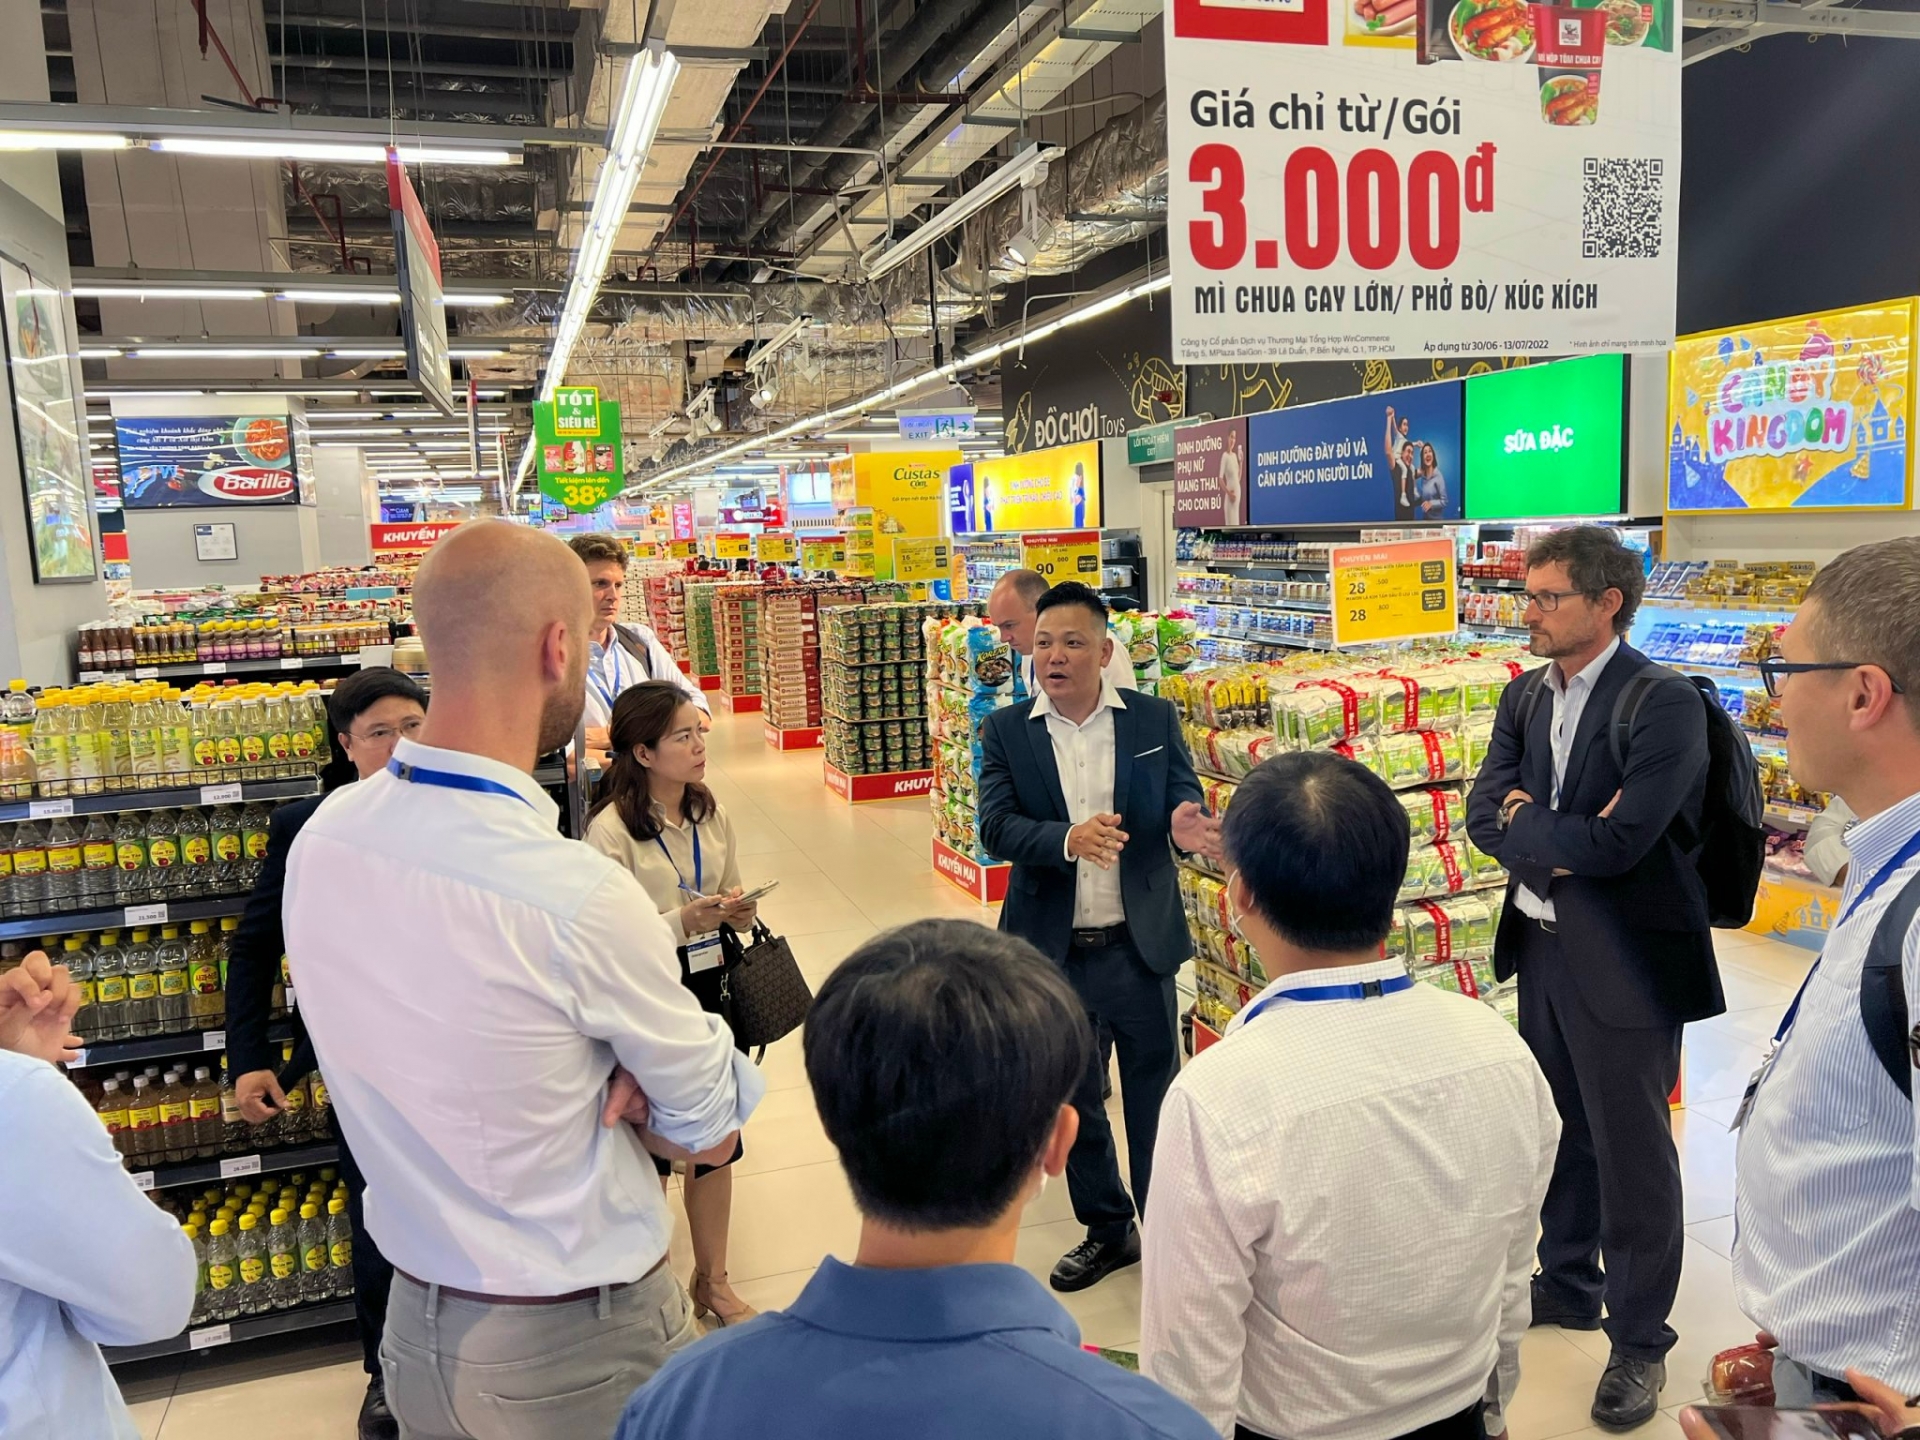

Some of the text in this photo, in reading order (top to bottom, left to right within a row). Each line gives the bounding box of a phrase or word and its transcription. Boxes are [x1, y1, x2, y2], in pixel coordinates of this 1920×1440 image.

[1190, 87, 1461, 140] Giá chỉ từ/Gói
[1188, 141, 1497, 270] 3.000đ
[1195, 277, 1598, 315] MÌ CHUA CAY LỚN/ PHỞ BÒ/ XÚC XÍCH
[1180, 338, 1200, 347] Công
[1201, 338, 1208, 347] ty
[1240, 336, 1256, 346] Dịch
[1267, 336, 1294, 346] Thương
[1309, 334, 1326, 345] Tổng
[1327, 335, 1342, 344] Hợp
[1343, 335, 1390, 343] WinCommerce
[1423, 340, 1549, 352] Áp dụng từ 30/06 13/07/2022
[1611, 340, 1627, 348] mang
[1268, 347, 1277, 355] 39
[1368, 345, 1395, 353] TP.HCM
[1721, 361, 1830, 414] CANDY
[557, 389, 594, 406] TỐT
[572, 407, 581, 415] &
[558, 416, 582, 429] SIÊU
[1035, 402, 1126, 448] ĐỒ CHƠI Toys
[908, 431, 929, 439] EXIT
[1503, 424, 1575, 454] SỮA ĐẶC
[1713, 407, 1847, 457] KINGDOM
[1146, 447, 1156, 456] EXIT
[1177, 435, 1223, 456] DINH DƯỠNG
[1257, 436, 1368, 467] DINH DƯỠNG ĐẦY ĐỦ VÀ
[893, 467, 940, 481] Custas
[1177, 456, 1206, 476] PHỤ NỮ
[1257, 460, 1373, 488] CÂN ĐỐI CHO NGƯỜI LỚN
[222, 473, 291, 490] Barilla
[1177, 477, 1221, 493] MANG THAI,
[563, 484, 607, 506] 38%
[1177, 493, 1222, 512] CHO CON BÚ
[383, 526, 436, 543] KHUYẾN
[1036, 562, 1054, 575] 90
[1349, 582, 1366, 595] 28
[1349, 609, 1367, 622] 28
[977, 645, 1009, 662] KORENO
[937, 853, 963, 878] KHUYẾN
